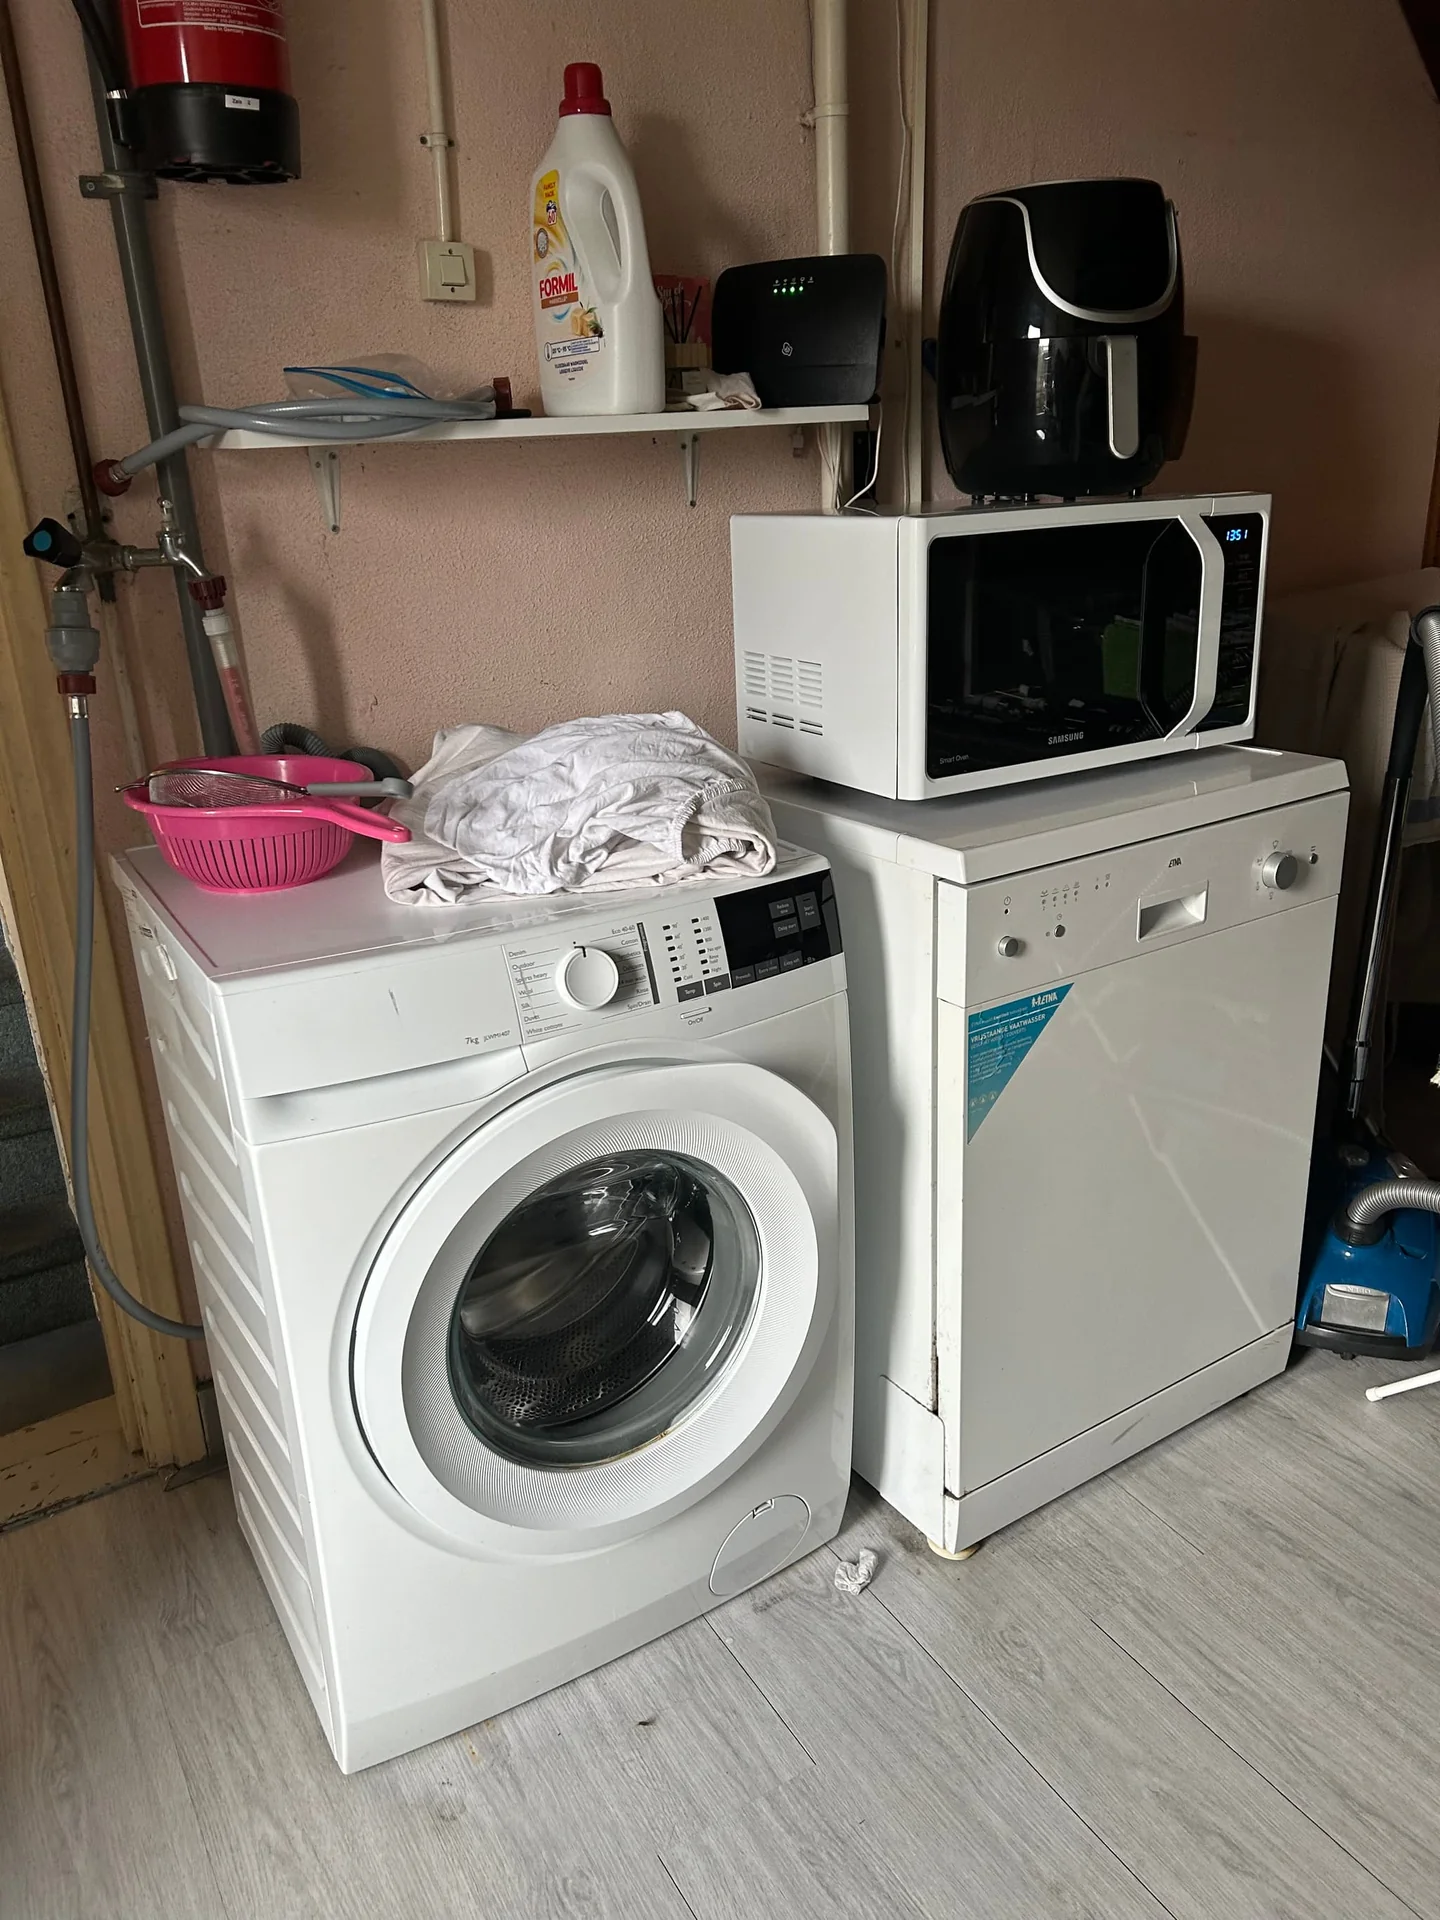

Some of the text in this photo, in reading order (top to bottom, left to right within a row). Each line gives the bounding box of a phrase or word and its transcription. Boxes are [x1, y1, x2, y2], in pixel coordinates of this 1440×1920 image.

[540, 272, 578, 298] FORMIL
[1048, 731, 1084, 745] SAMSUNG
[939, 754, 969, 765] Smart Oven
[1168, 857, 1182, 868] ETNA
[508, 950, 527, 958] Denim
[512, 961, 536, 970] Outdoor
[1040, 992, 1058, 1006] ETNA
[627, 1000, 651, 1010] Spin/Drain
[687, 1017, 703, 1025] On/Off
[1009, 1013, 1046, 1030] VAATWASSER
[526, 1022, 563, 1035] White cottons
[464, 1036, 480, 1045] 7kg
